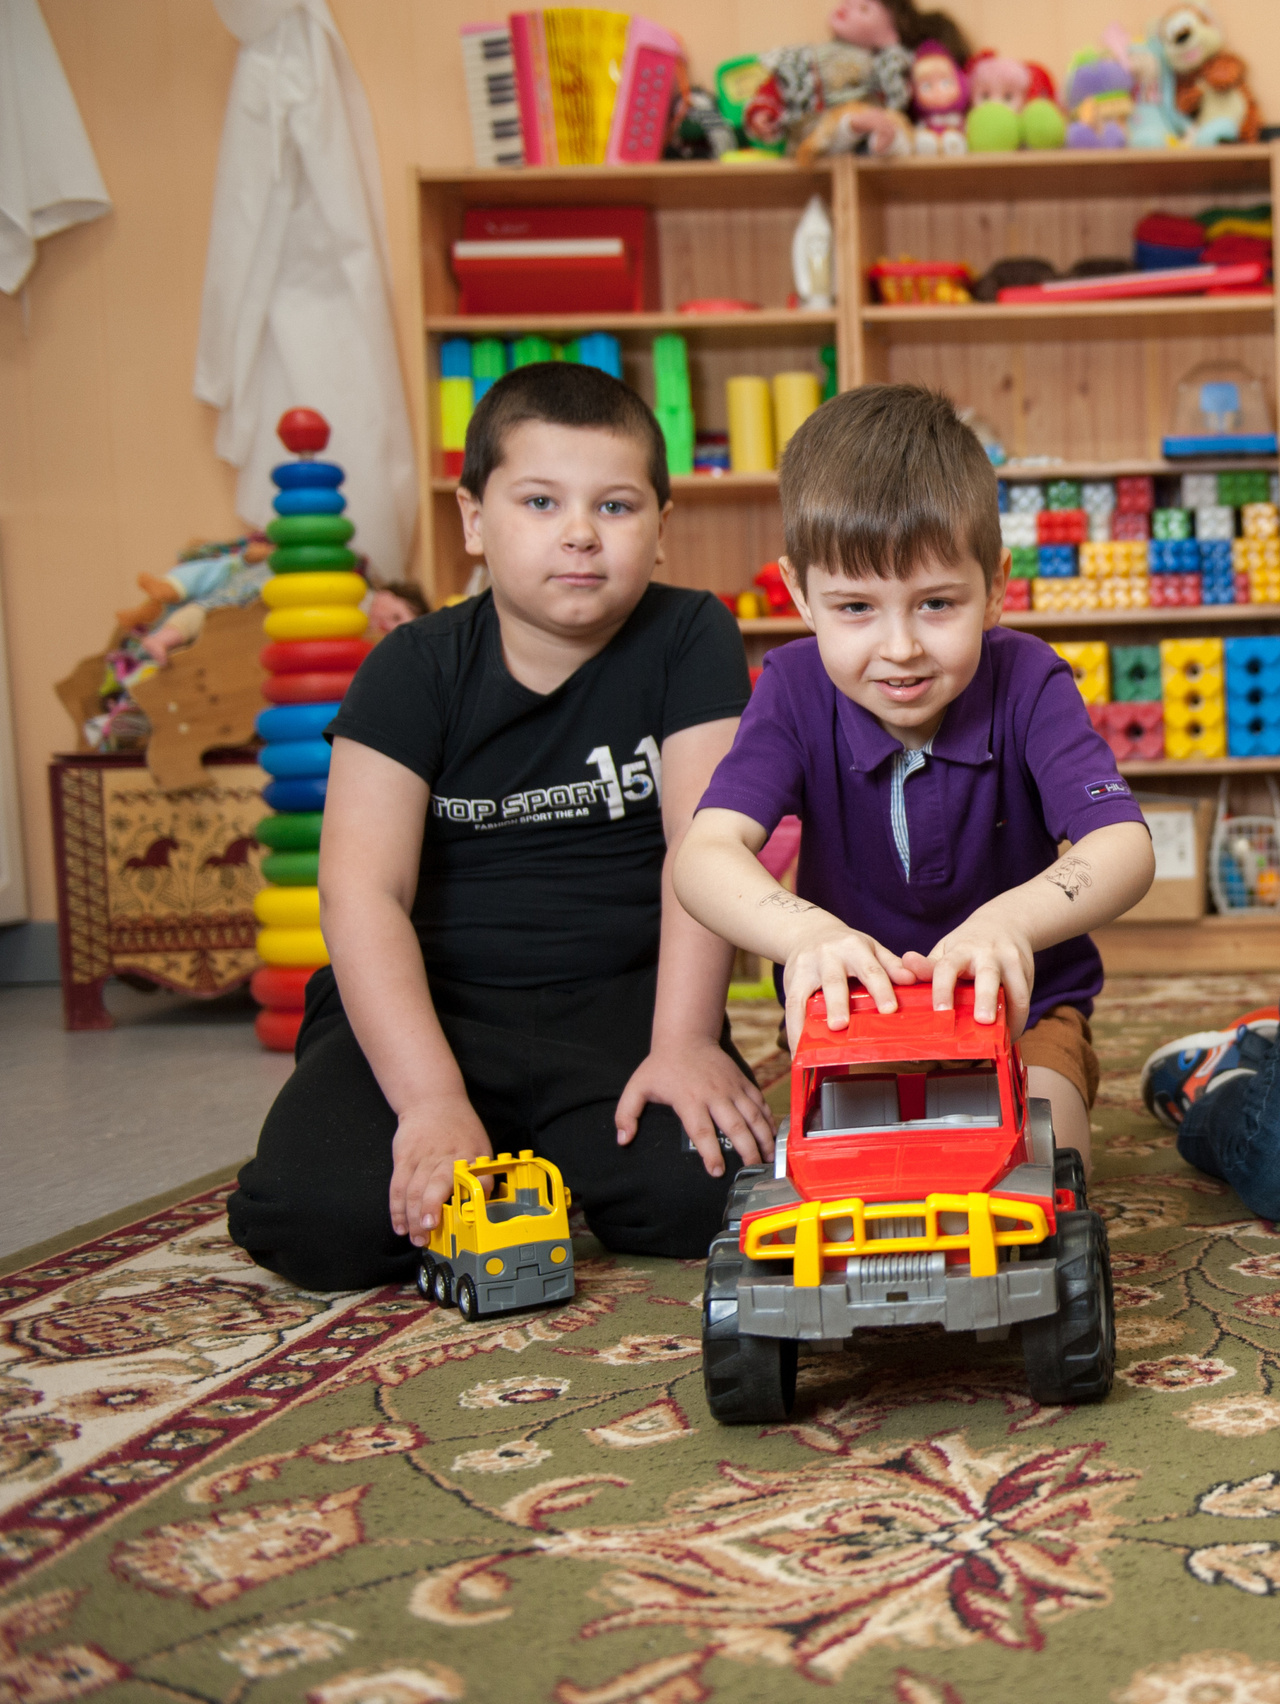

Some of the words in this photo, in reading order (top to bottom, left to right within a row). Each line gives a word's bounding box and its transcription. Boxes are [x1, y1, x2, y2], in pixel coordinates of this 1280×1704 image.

[432, 794, 497, 822] TOP
[502, 780, 613, 818] SPORT
[474, 817, 518, 831] FASHION
[519, 810, 553, 824] SPORT
[554, 808, 574, 820] THE
